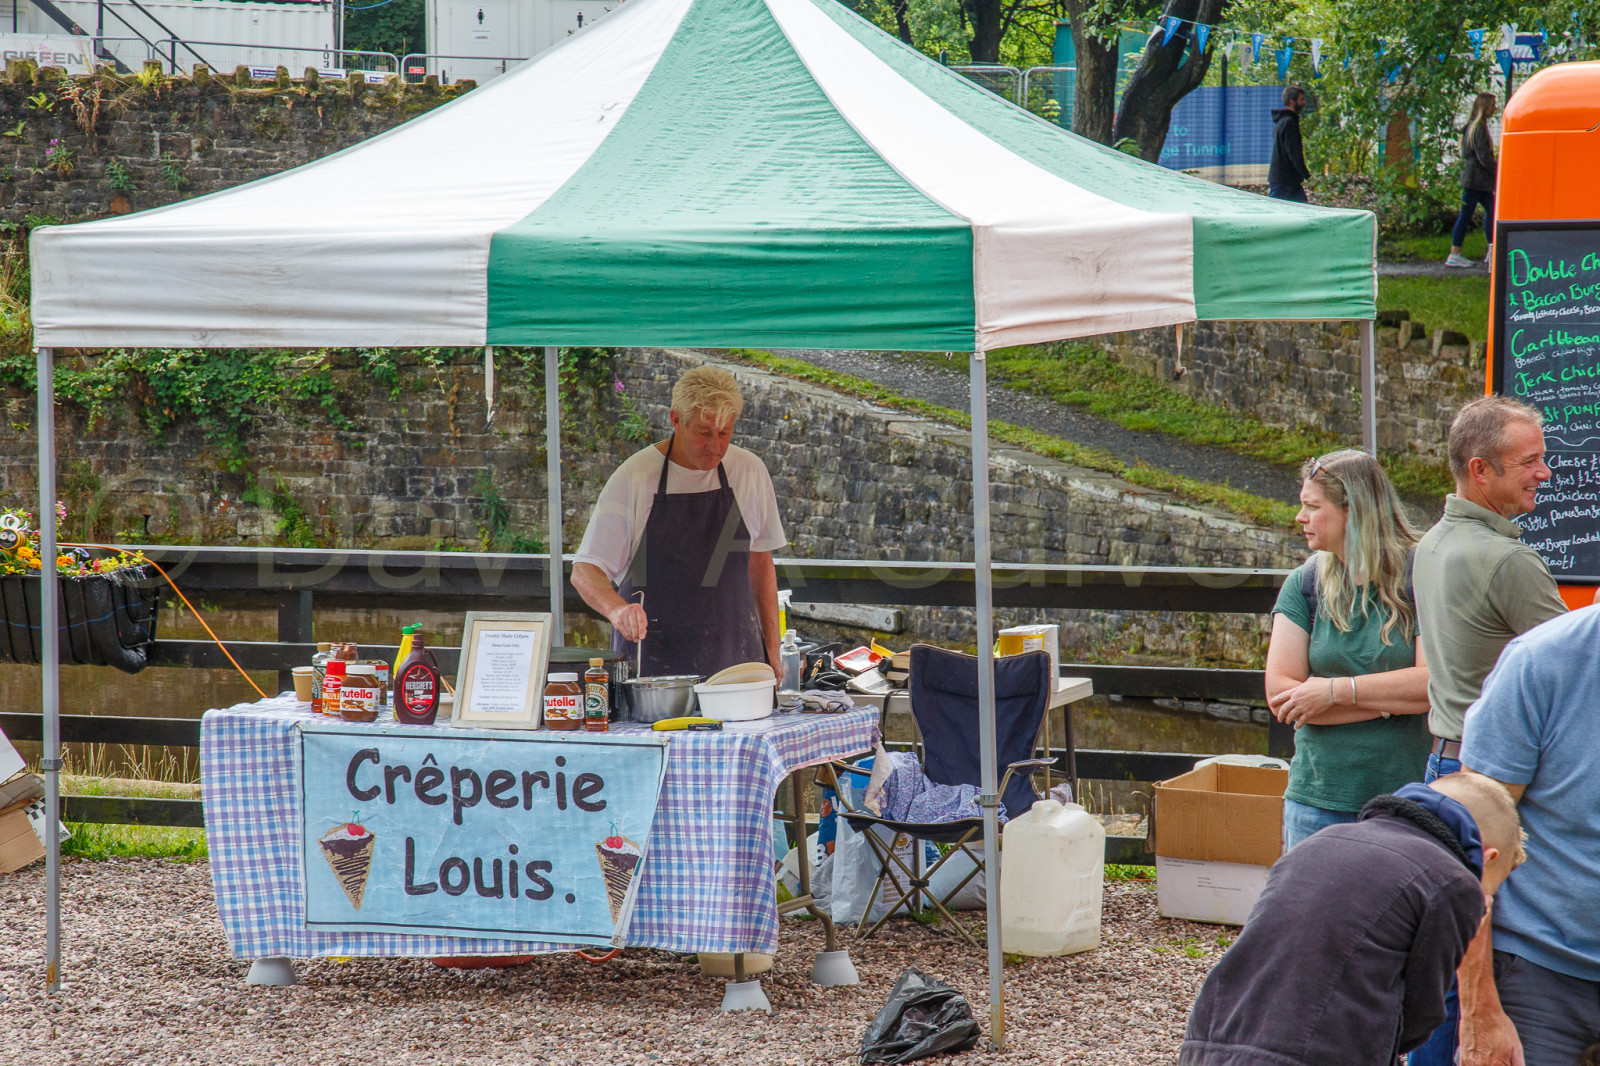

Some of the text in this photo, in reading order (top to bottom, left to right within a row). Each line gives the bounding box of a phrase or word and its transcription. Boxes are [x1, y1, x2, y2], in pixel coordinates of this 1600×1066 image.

[3, 50, 83, 65] GIFFEN
[1173, 125, 1188, 137] to
[1183, 142, 1231, 156] Tunnel
[1508, 248, 1577, 286] Double
[1521, 290, 1566, 310] Bacon
[1511, 328, 1600, 357] Caribbean
[1515, 371, 1557, 395] Jerk
[1543, 424, 1567, 435] esan,
[1548, 454, 1587, 468] Cheese
[1556, 490, 1597, 502] Chicken
[405, 681, 433, 690] HERSHEY'S
[341, 689, 373, 699] nutella
[545, 696, 576, 707] nutella
[346, 748, 607, 826] Crêperie
[405, 836, 576, 904] Louis.
